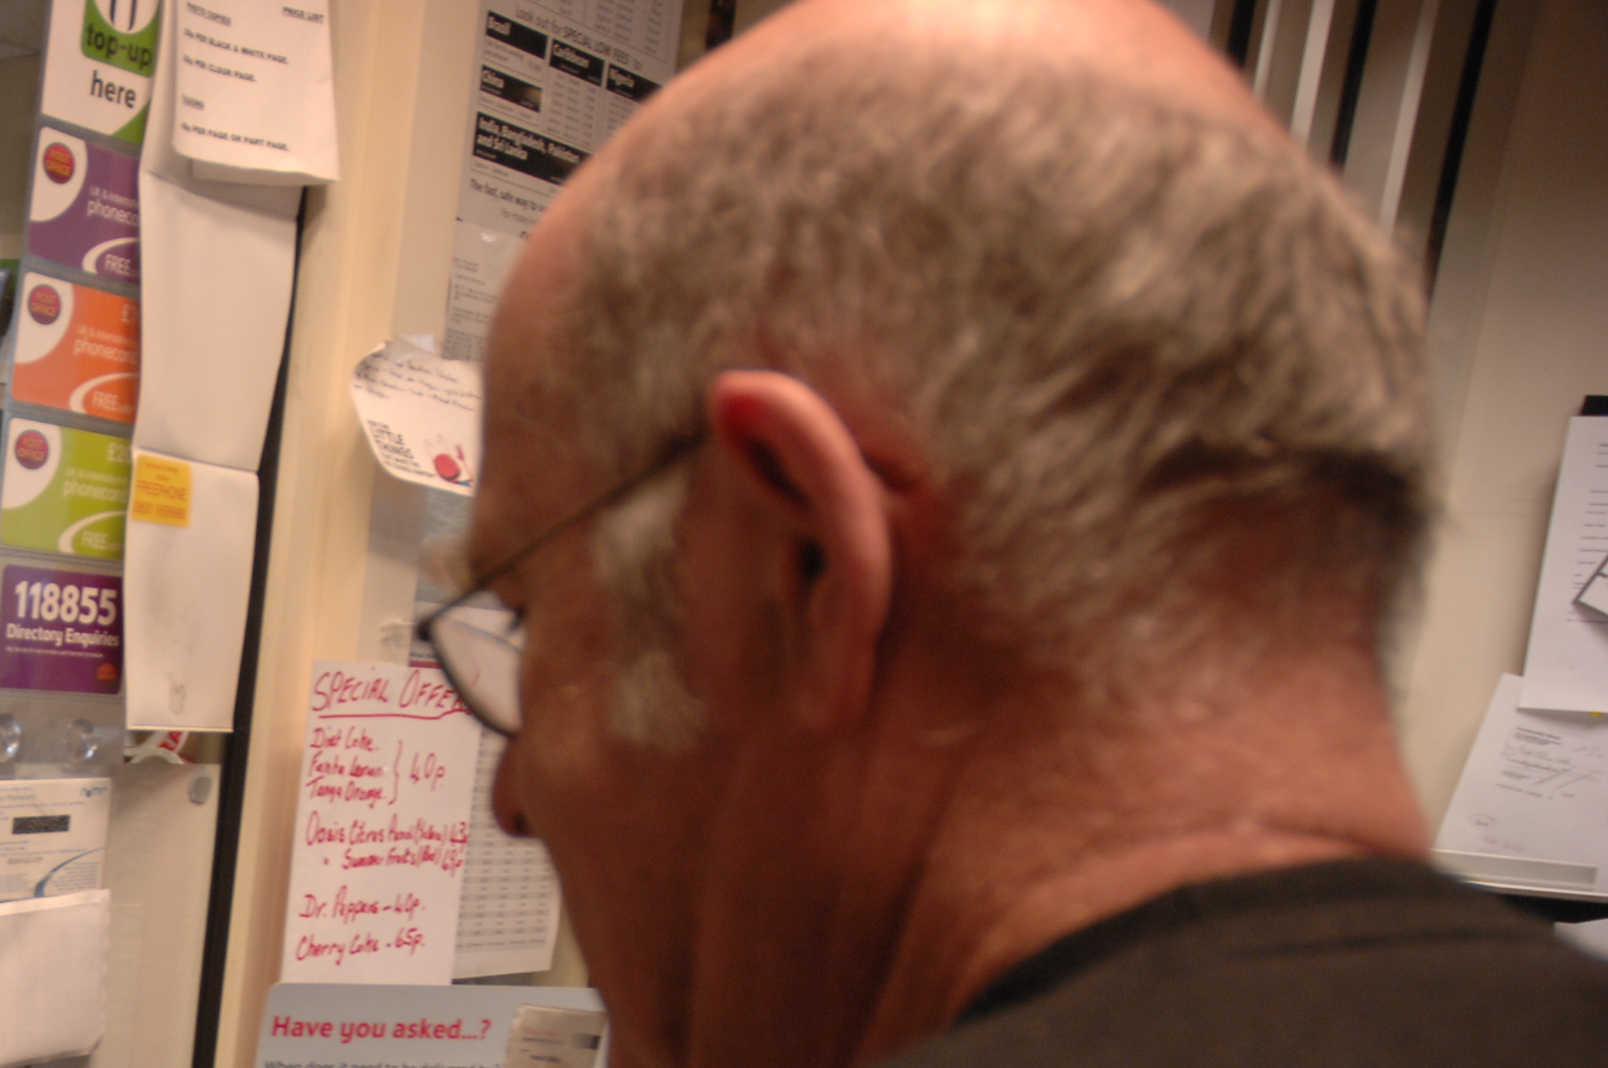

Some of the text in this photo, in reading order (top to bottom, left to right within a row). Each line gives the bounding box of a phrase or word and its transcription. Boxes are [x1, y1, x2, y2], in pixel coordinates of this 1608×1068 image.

[283, 6, 324, 23] PRICE LIST
[488, 16, 511, 37] Brazil
[87, 23, 152, 70] top-up
[209, 38, 230, 51] BLACK
[242, 47, 265, 59] WHITE
[564, 26, 593, 50] SPECIAL
[554, 42, 590, 69] Caribbean
[90, 70, 136, 109] here
[483, 69, 505, 90] China
[610, 68, 635, 88] Nigeria
[193, 125, 206, 136] PER
[208, 129, 228, 140] PAGE
[243, 136, 264, 147] PART
[476, 133, 493, 149] and
[548, 142, 581, 165] Pakistan
[136, 479, 188, 501] FREEPHONE
[14, 580, 118, 626] 118855
[6, 622, 120, 649] Directory Enquiries
[312, 671, 390, 712] SPECIAL
[310, 727, 342, 749] Diet
[308, 751, 345, 777] Fanta
[306, 776, 343, 804] Tango
[307, 810, 345, 846] Oasis
[349, 819, 385, 846] Citrus
[299, 893, 328, 918] Dr.
[296, 934, 345, 966] Cherry
[349, 933, 379, 955] Coke
[272, 1015, 493, 1044] Have you asked...?
